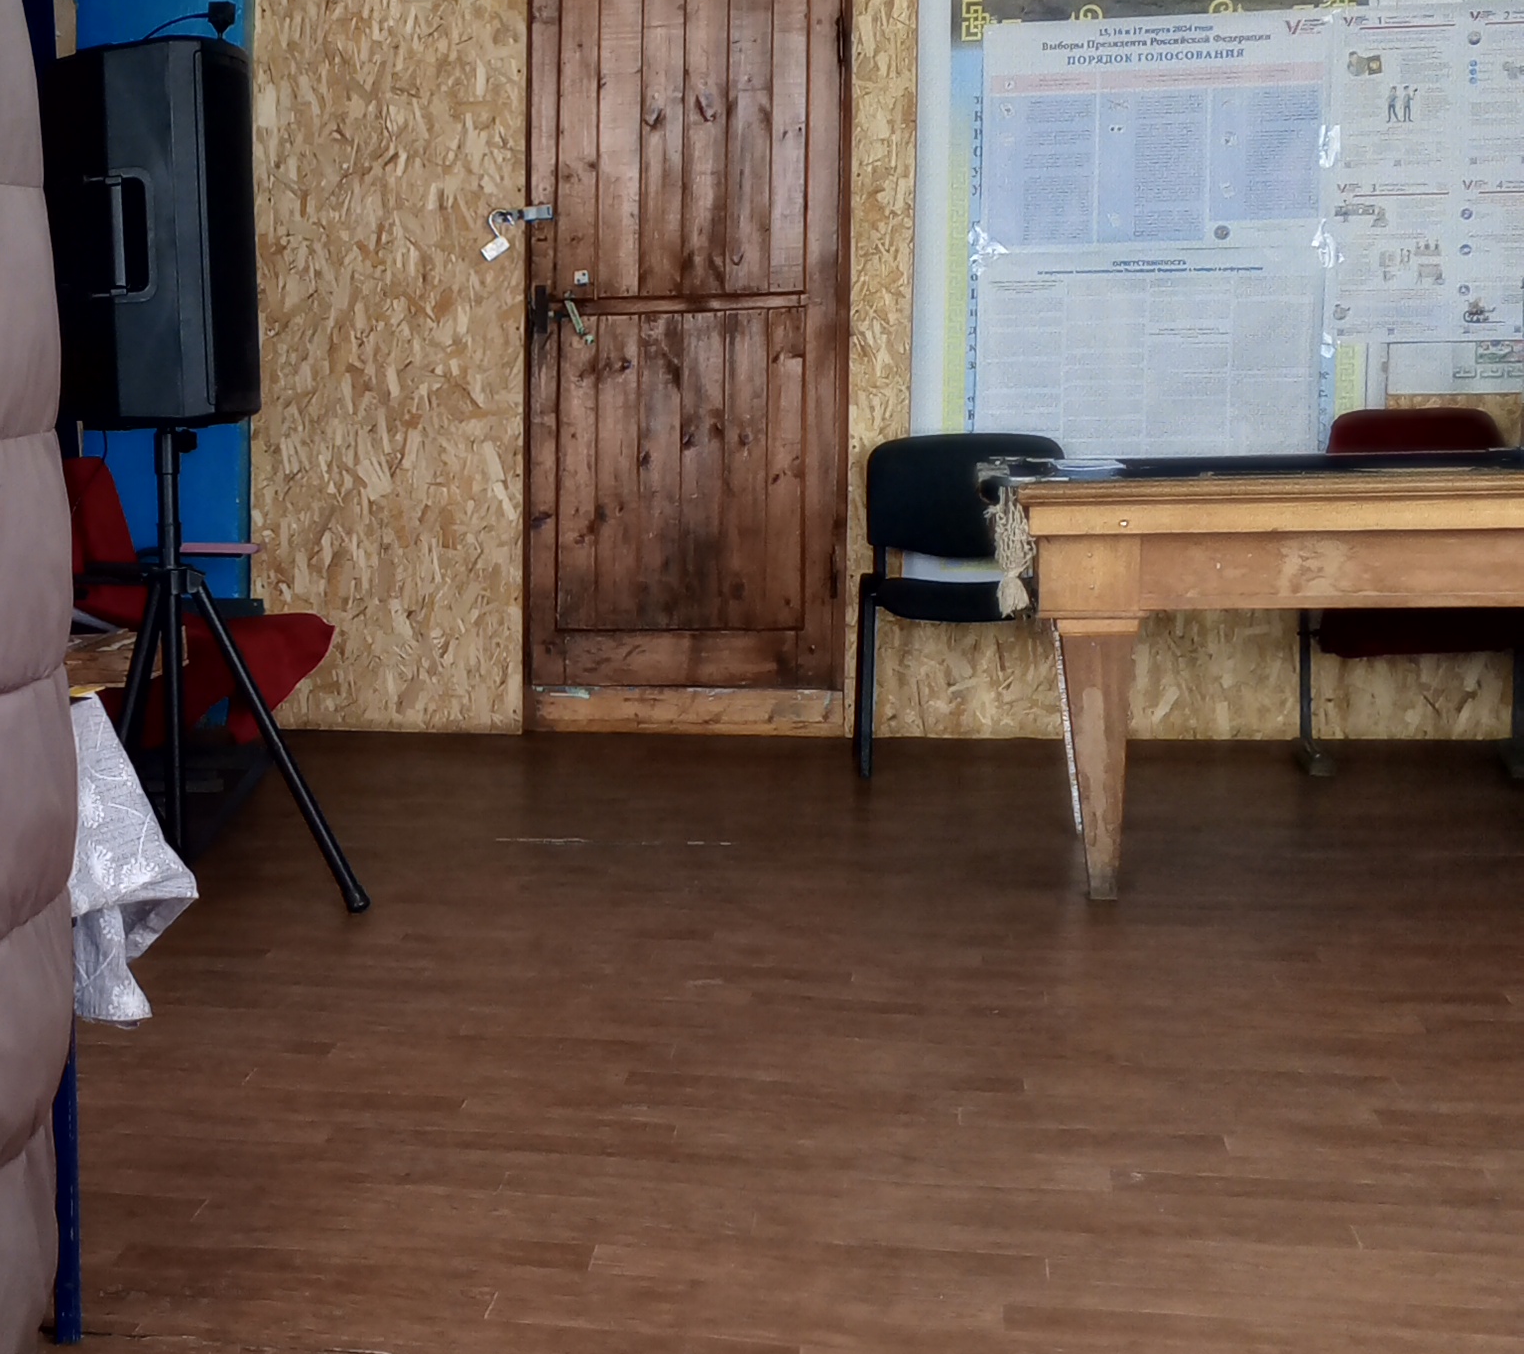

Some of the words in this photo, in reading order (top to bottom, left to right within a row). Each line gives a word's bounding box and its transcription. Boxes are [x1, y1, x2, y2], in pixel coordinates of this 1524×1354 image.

[1041, 41, 1084, 51] Выборы
[1086, 39, 1147, 51] Президента
[1150, 35, 1210, 46] Российской
[1067, 52, 1133, 66] ПОРЯДОК
[1137, 48, 1245, 62] ГОЛОСОВАНИЯ
